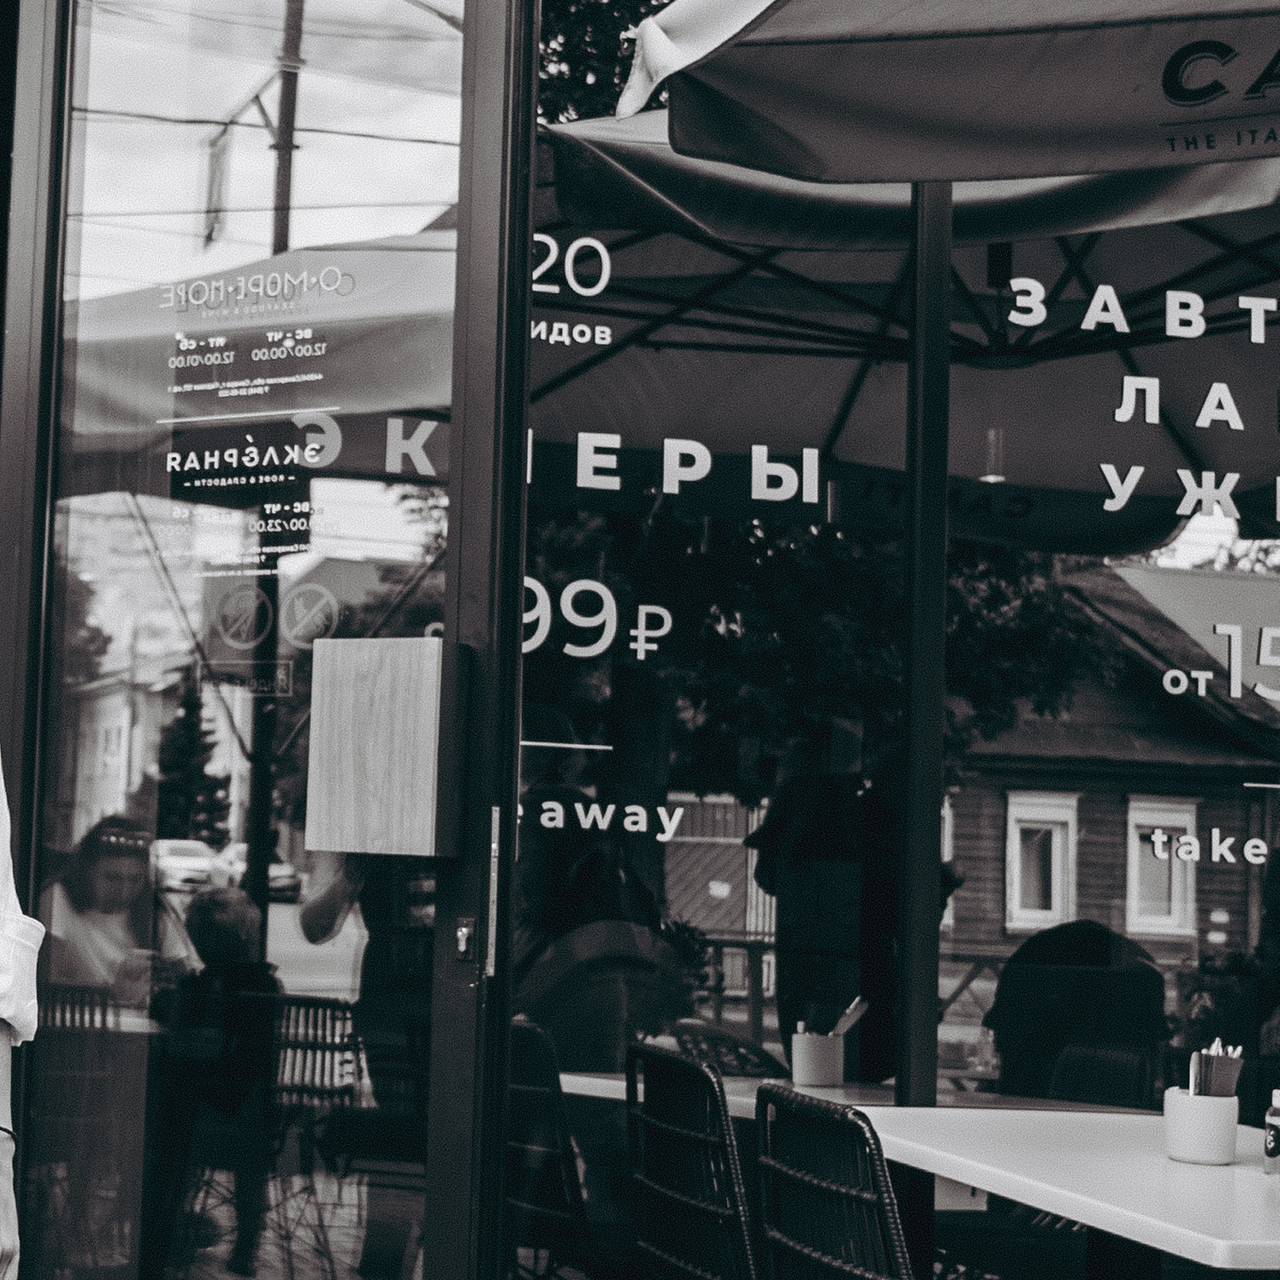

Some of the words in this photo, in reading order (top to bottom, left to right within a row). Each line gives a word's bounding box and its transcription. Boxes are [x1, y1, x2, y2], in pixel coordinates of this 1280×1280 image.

[1166, 134, 1216, 152] THE
[531, 232, 612, 297] 20
[1007, 277, 1278, 345] ЗАВТ
[540, 800, 685, 842] away
[1151, 827, 1269, 866] take
